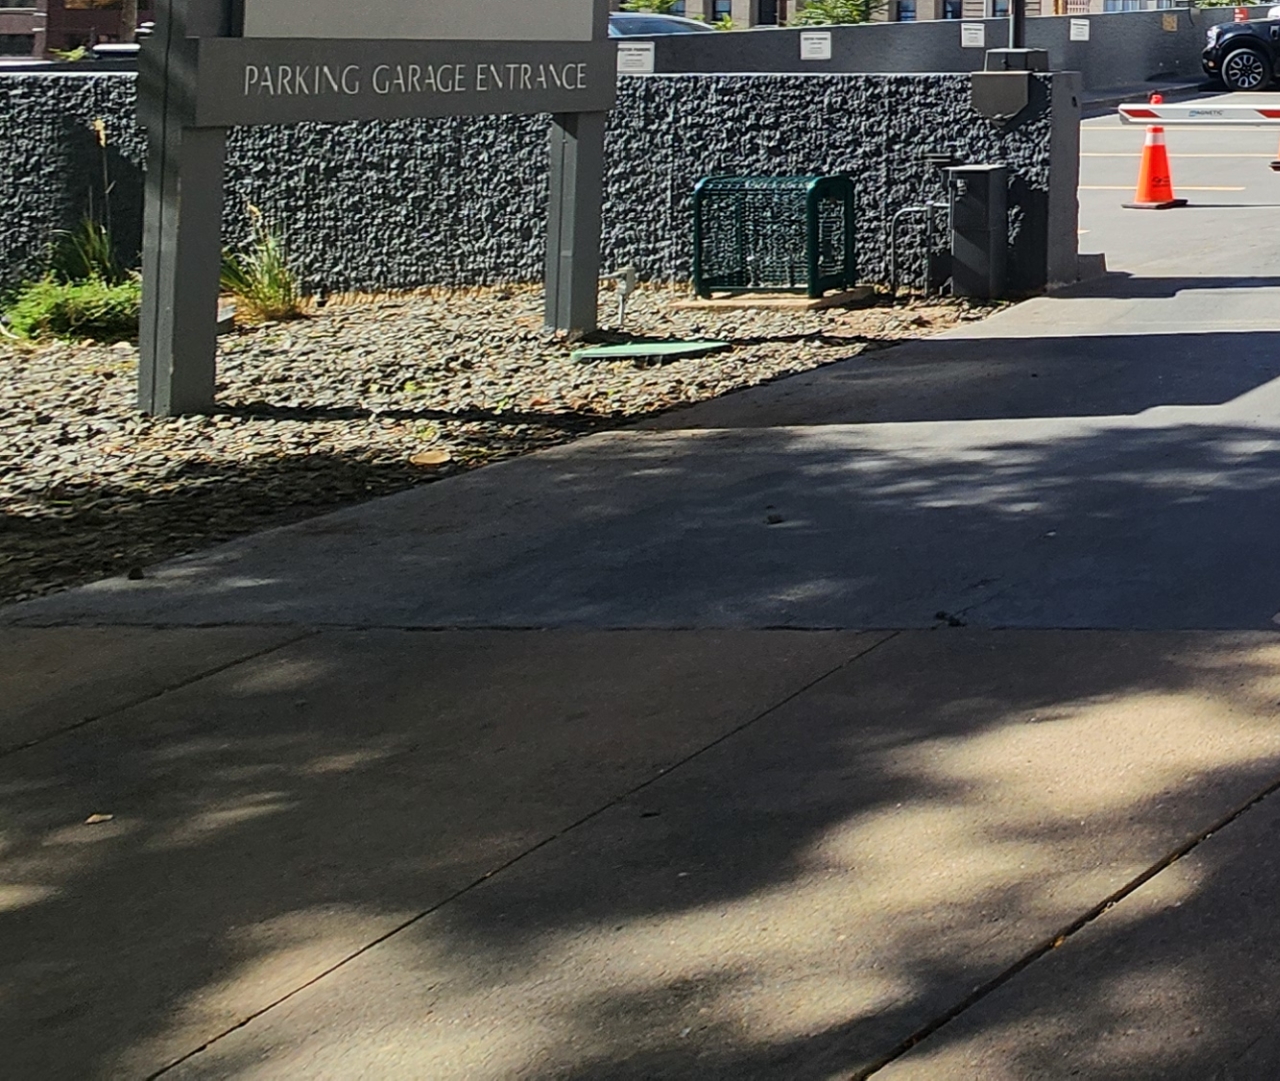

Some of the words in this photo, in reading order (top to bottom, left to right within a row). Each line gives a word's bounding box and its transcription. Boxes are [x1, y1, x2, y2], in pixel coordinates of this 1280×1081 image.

[243, 65, 360, 96] PARKING
[371, 64, 467, 95] GARAGE
[475, 63, 588, 91] ENTRANCE
